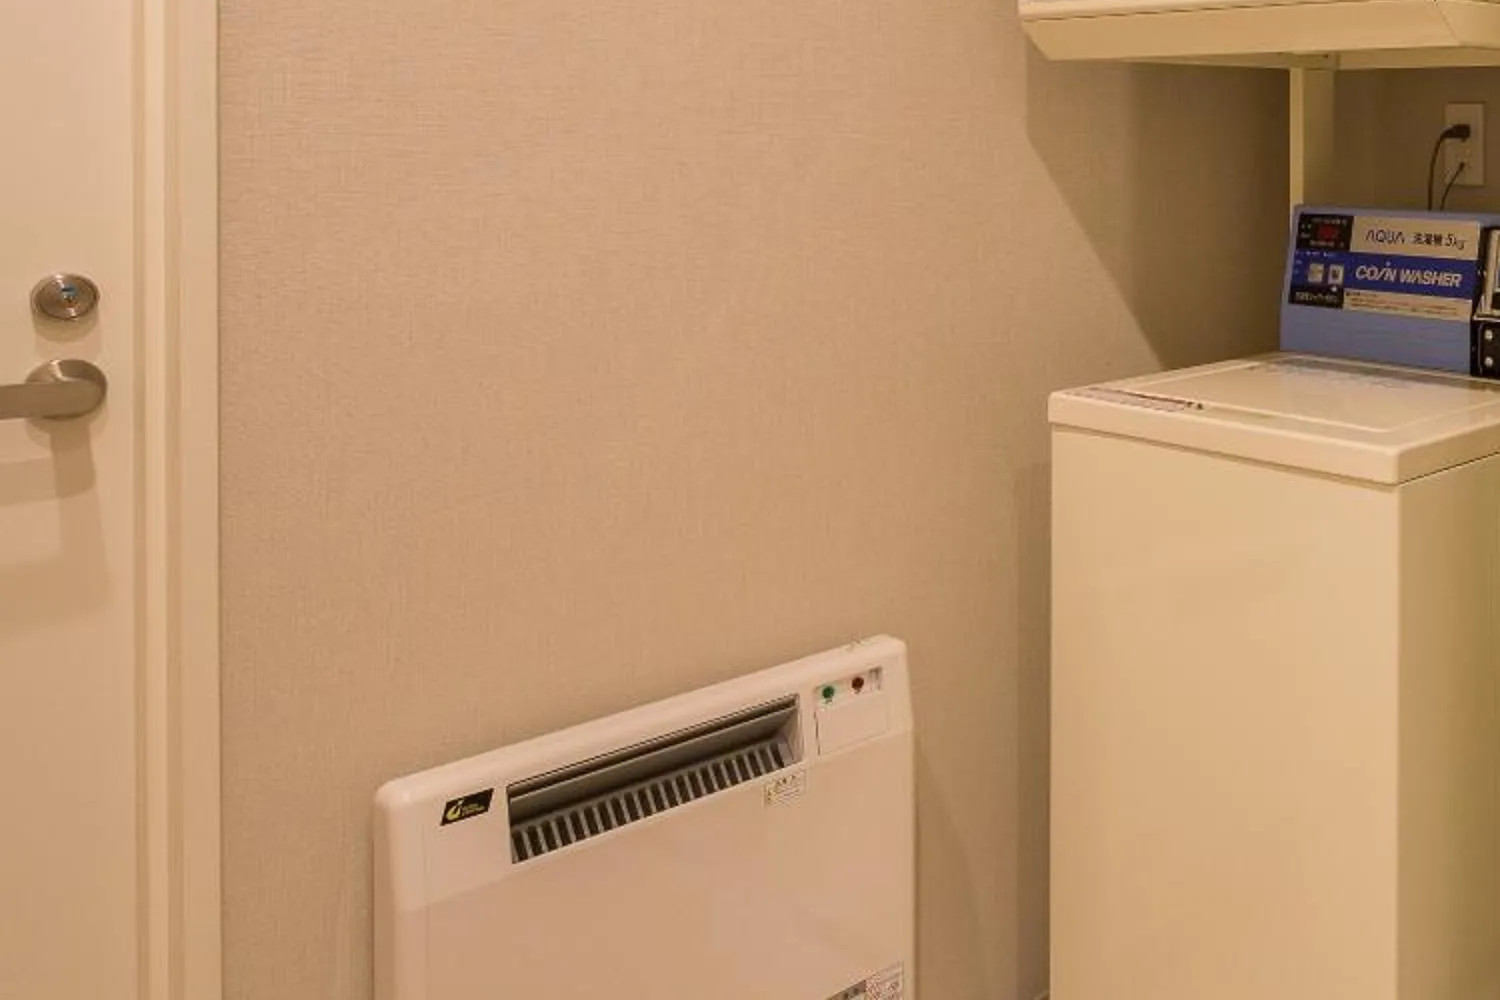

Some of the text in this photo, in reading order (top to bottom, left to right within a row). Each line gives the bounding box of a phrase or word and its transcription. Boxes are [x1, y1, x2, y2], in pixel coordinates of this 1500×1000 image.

[1365, 229, 1405, 245] AQUA
[1444, 232, 1468, 251] 5kg
[1355, 260, 1463, 289] COIN WASHER
